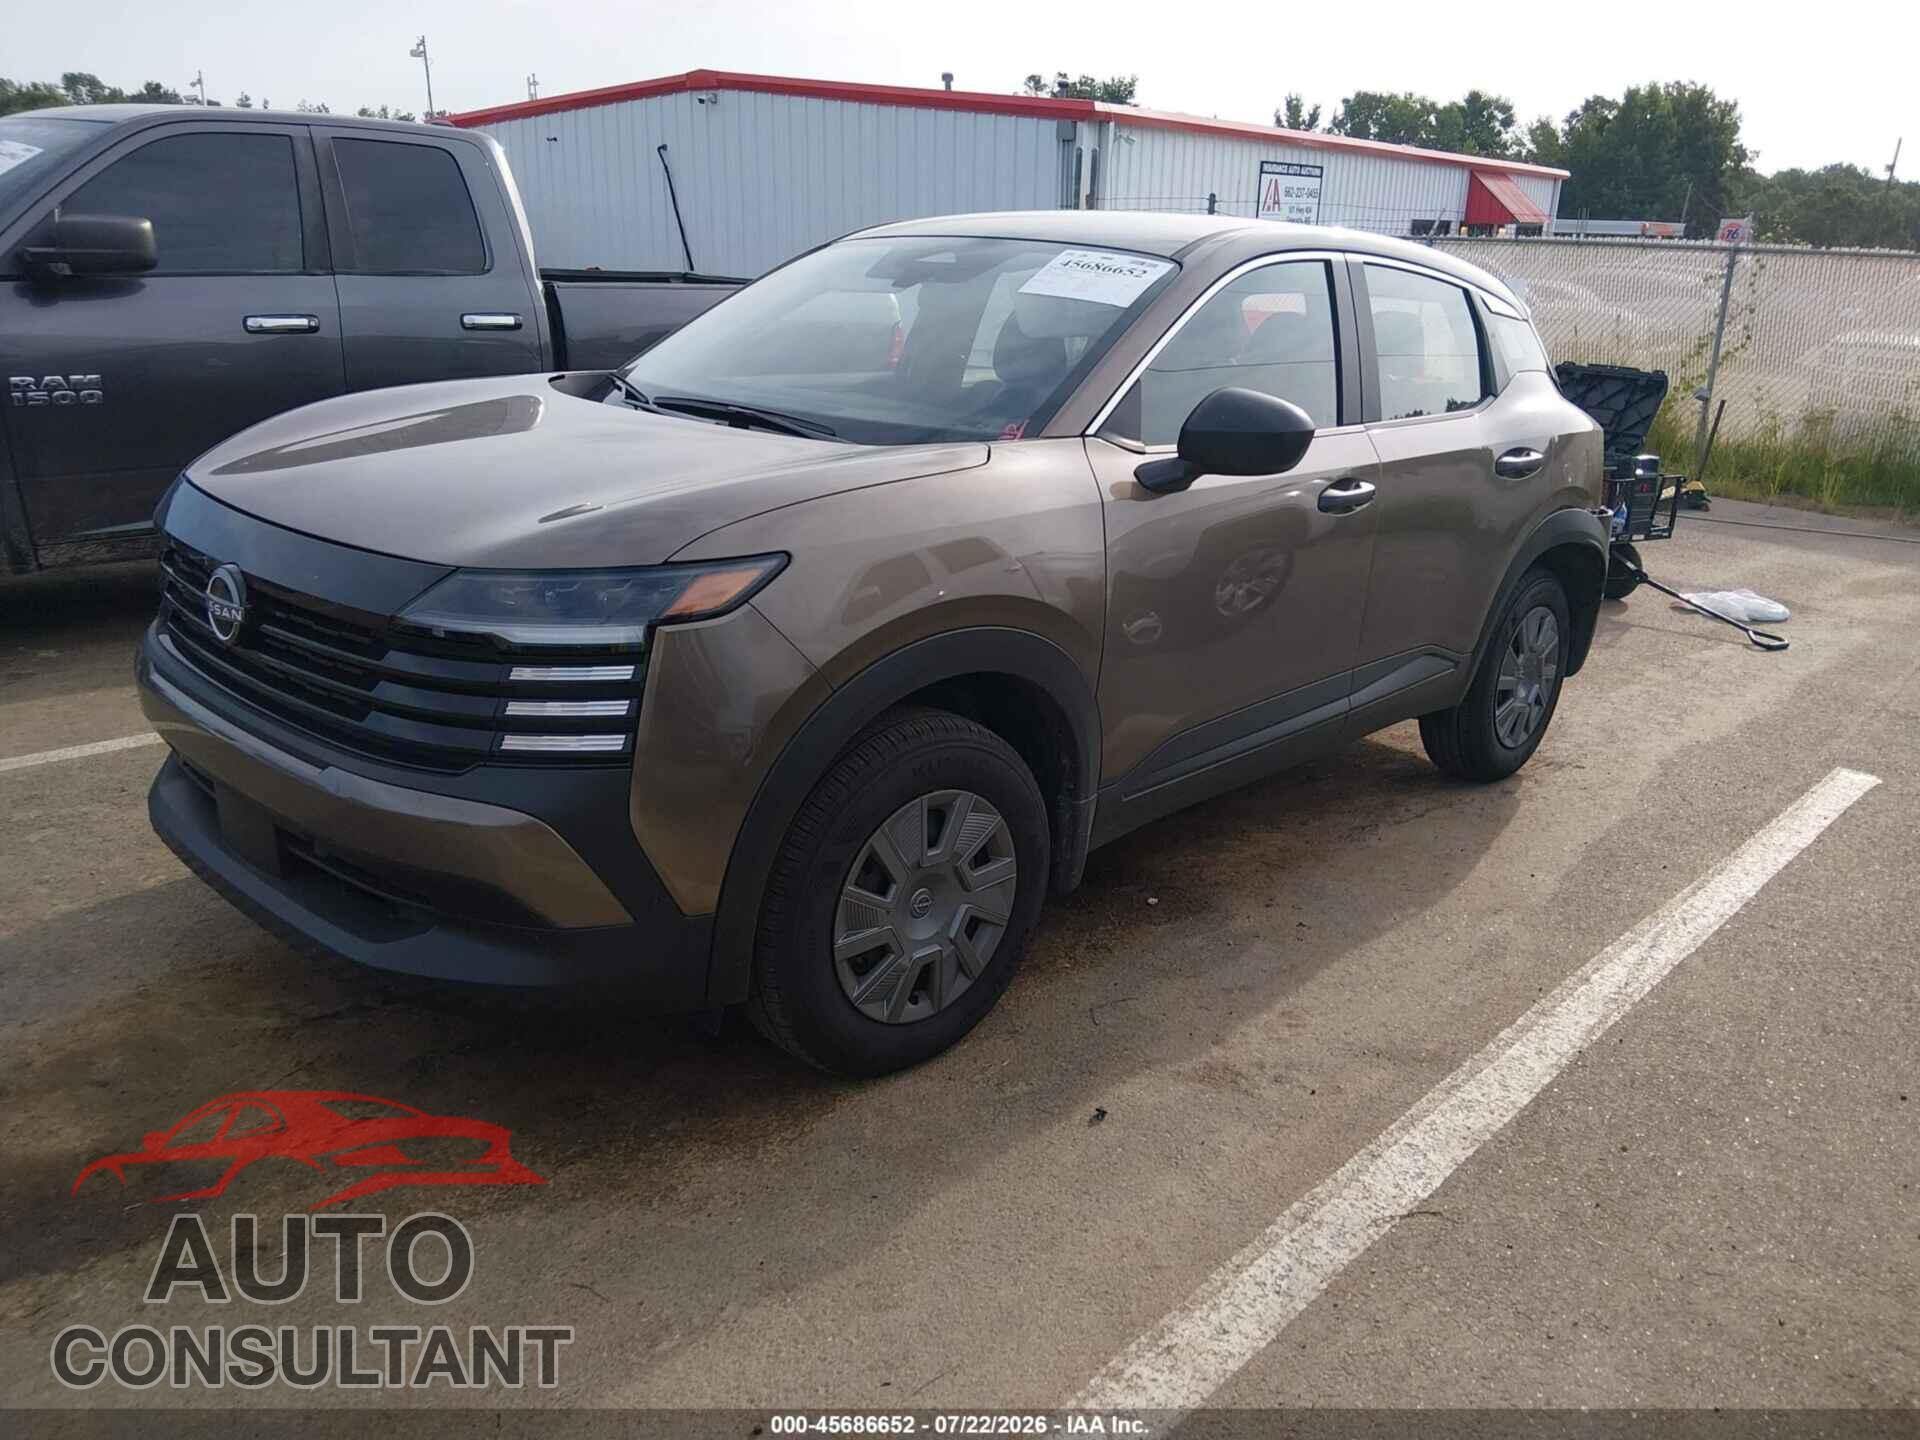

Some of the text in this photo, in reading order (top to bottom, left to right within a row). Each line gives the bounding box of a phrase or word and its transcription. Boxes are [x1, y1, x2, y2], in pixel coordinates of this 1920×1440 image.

[1060, 259, 1148, 279] 45686652
[9, 375, 102, 390] RAM
[10, 390, 103, 407] 1500
